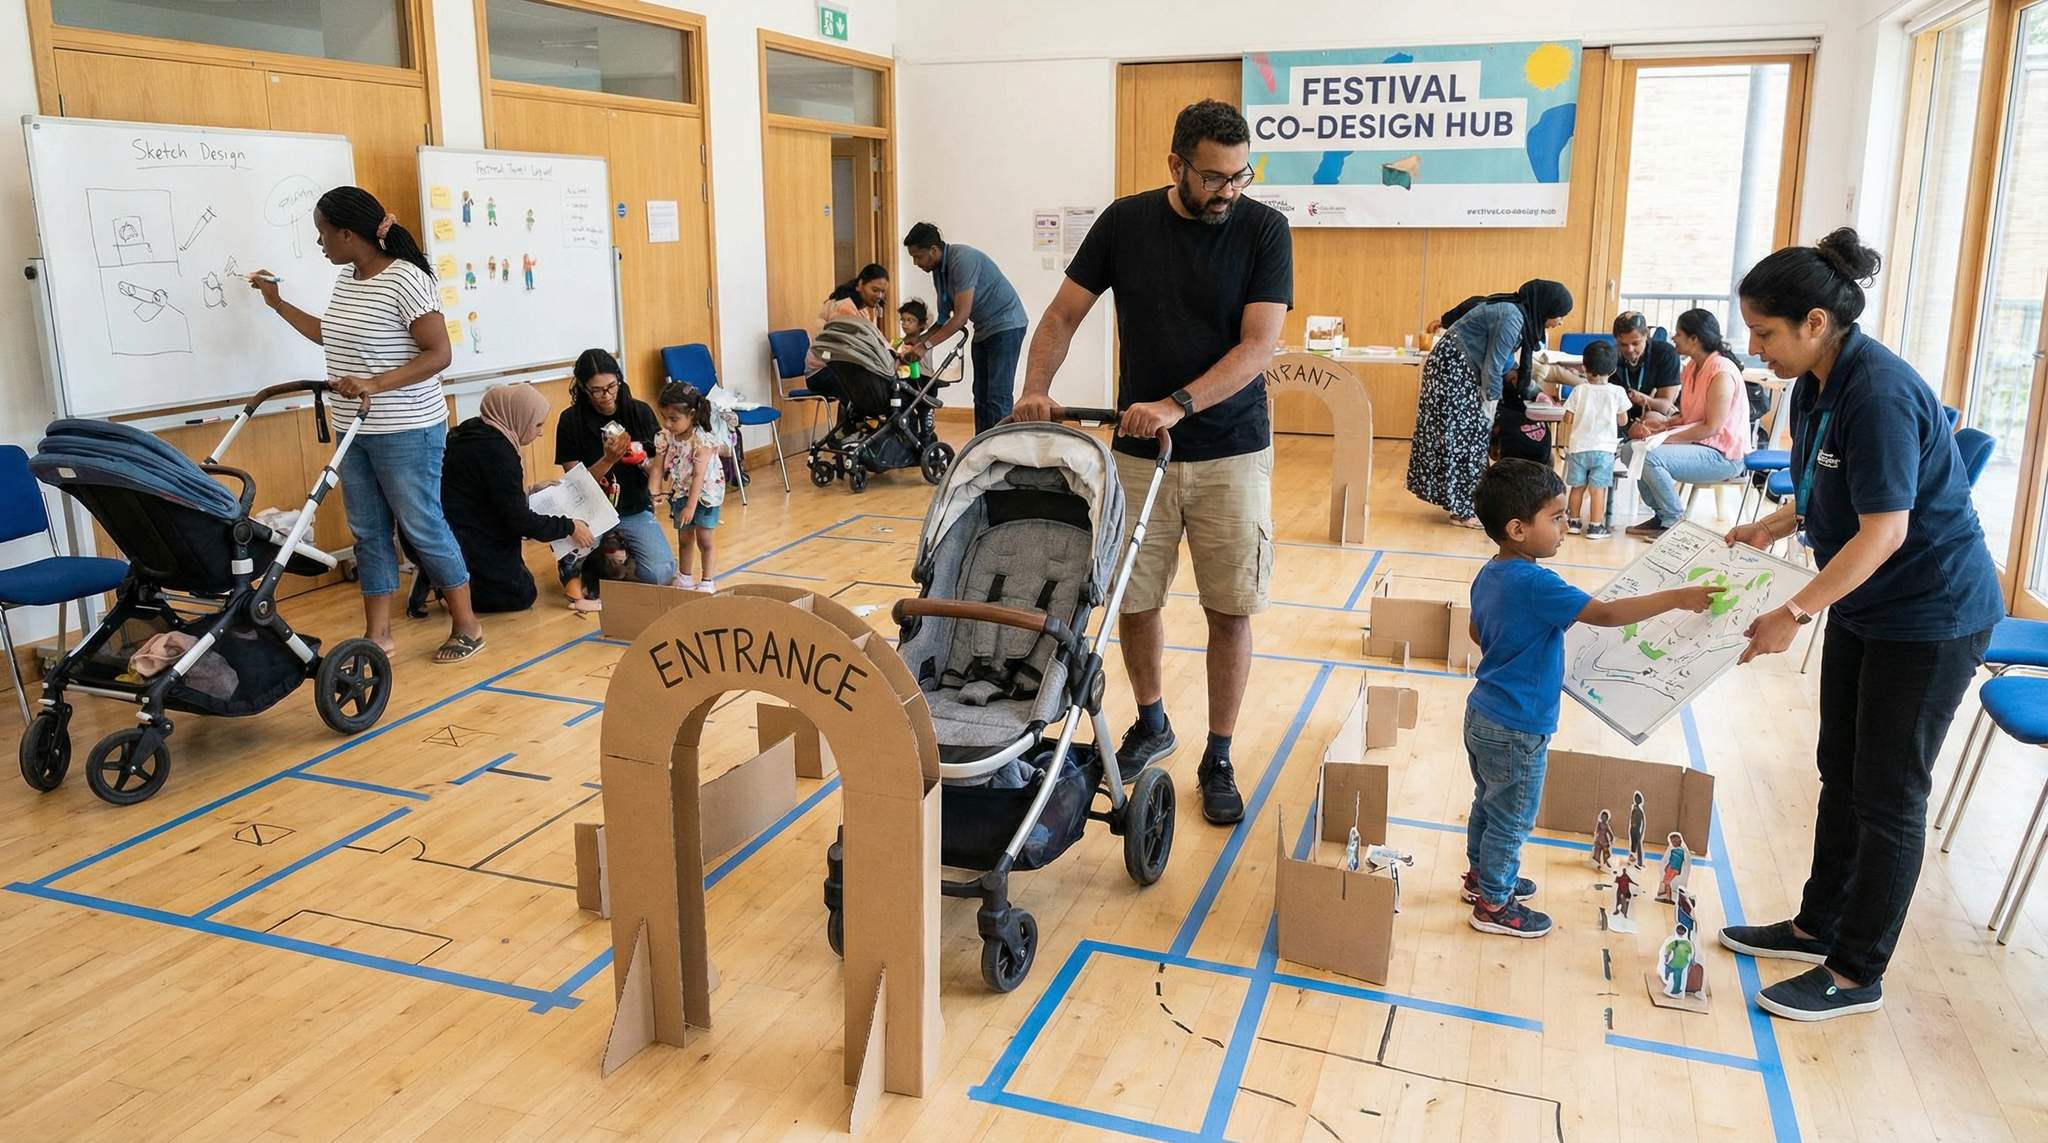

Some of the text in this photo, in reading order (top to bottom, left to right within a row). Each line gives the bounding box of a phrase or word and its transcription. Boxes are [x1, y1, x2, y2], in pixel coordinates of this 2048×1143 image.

[1302, 73, 1466, 106] FESTIVAL
[1255, 111, 1514, 140] CO-DESIGN HUB
[132, 138, 246, 169] Sketch Design
[649, 628, 868, 712] ENTRANCE
